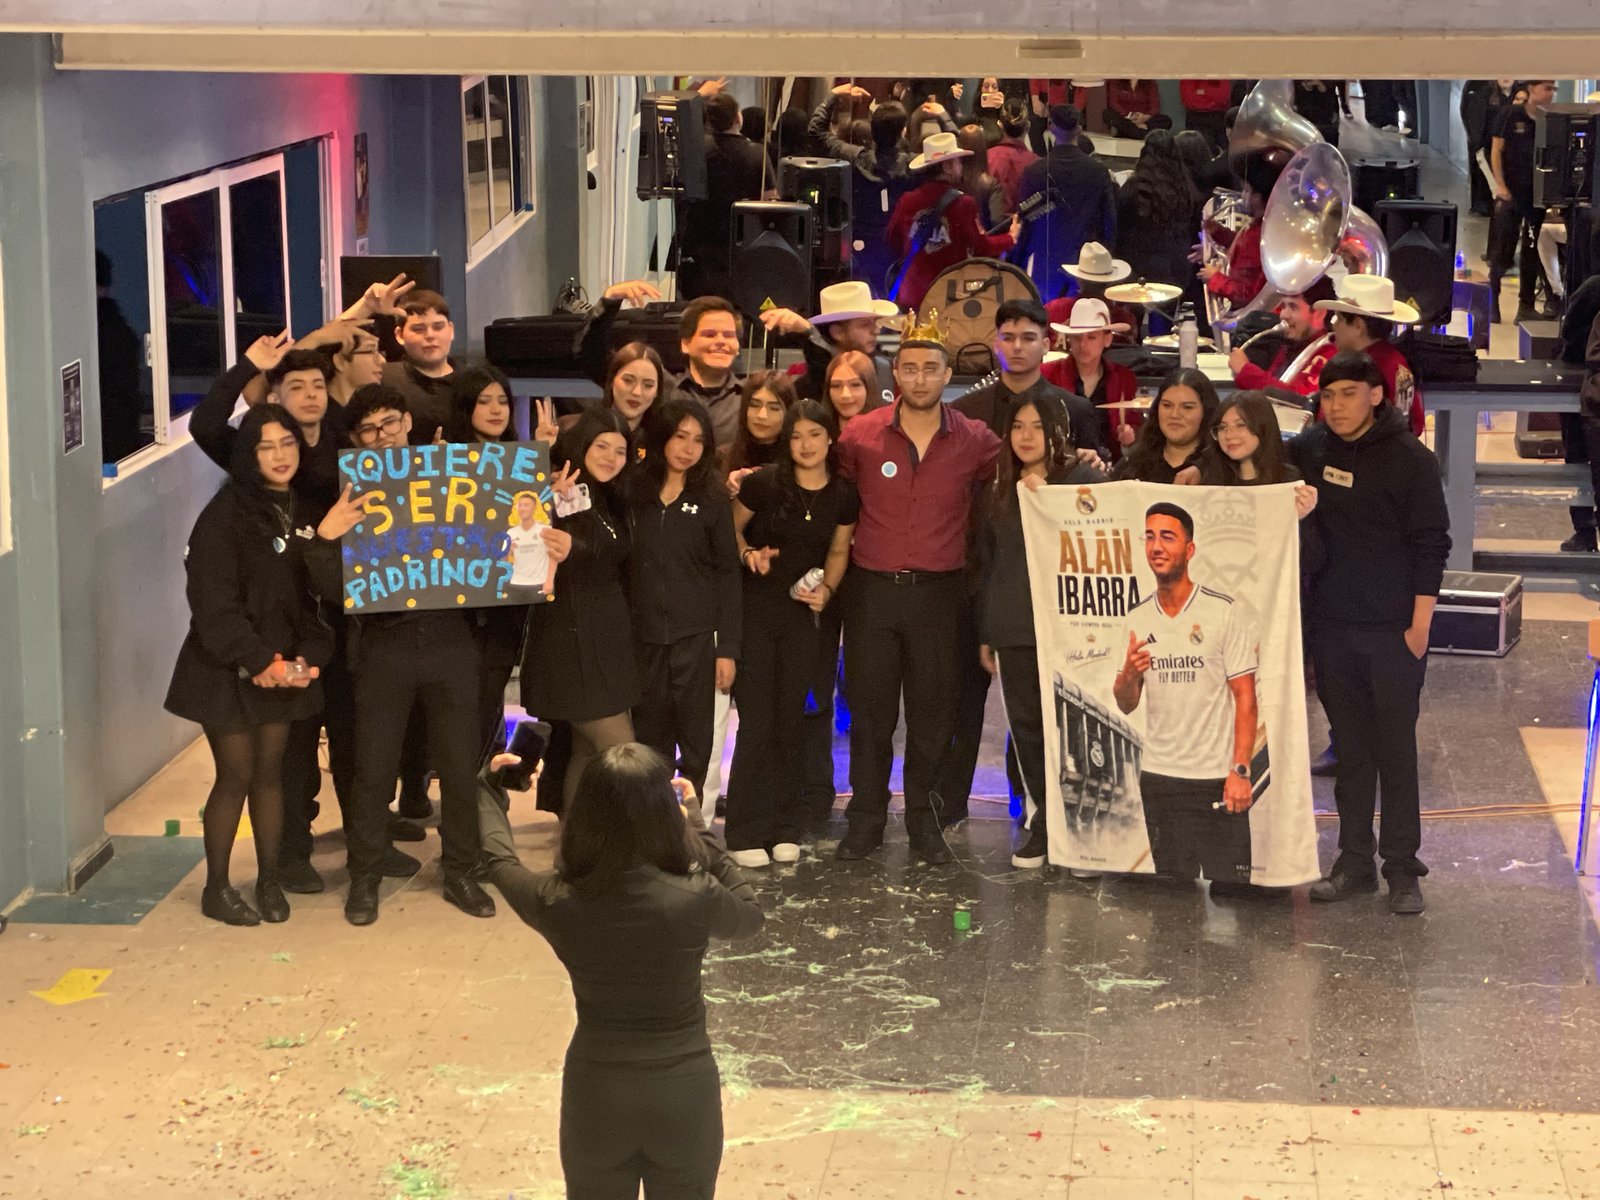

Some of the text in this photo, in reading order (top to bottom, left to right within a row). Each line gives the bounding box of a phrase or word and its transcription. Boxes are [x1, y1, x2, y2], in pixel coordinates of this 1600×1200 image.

[363, 476, 478, 535] SER
[1058, 528, 1133, 575] ALAN
[345, 557, 514, 609] PADRINO?
[1057, 574, 1141, 617] IBARRA
[1150, 654, 1205, 670] Emirates
[1159, 671, 1196, 684] FLY BETTER
